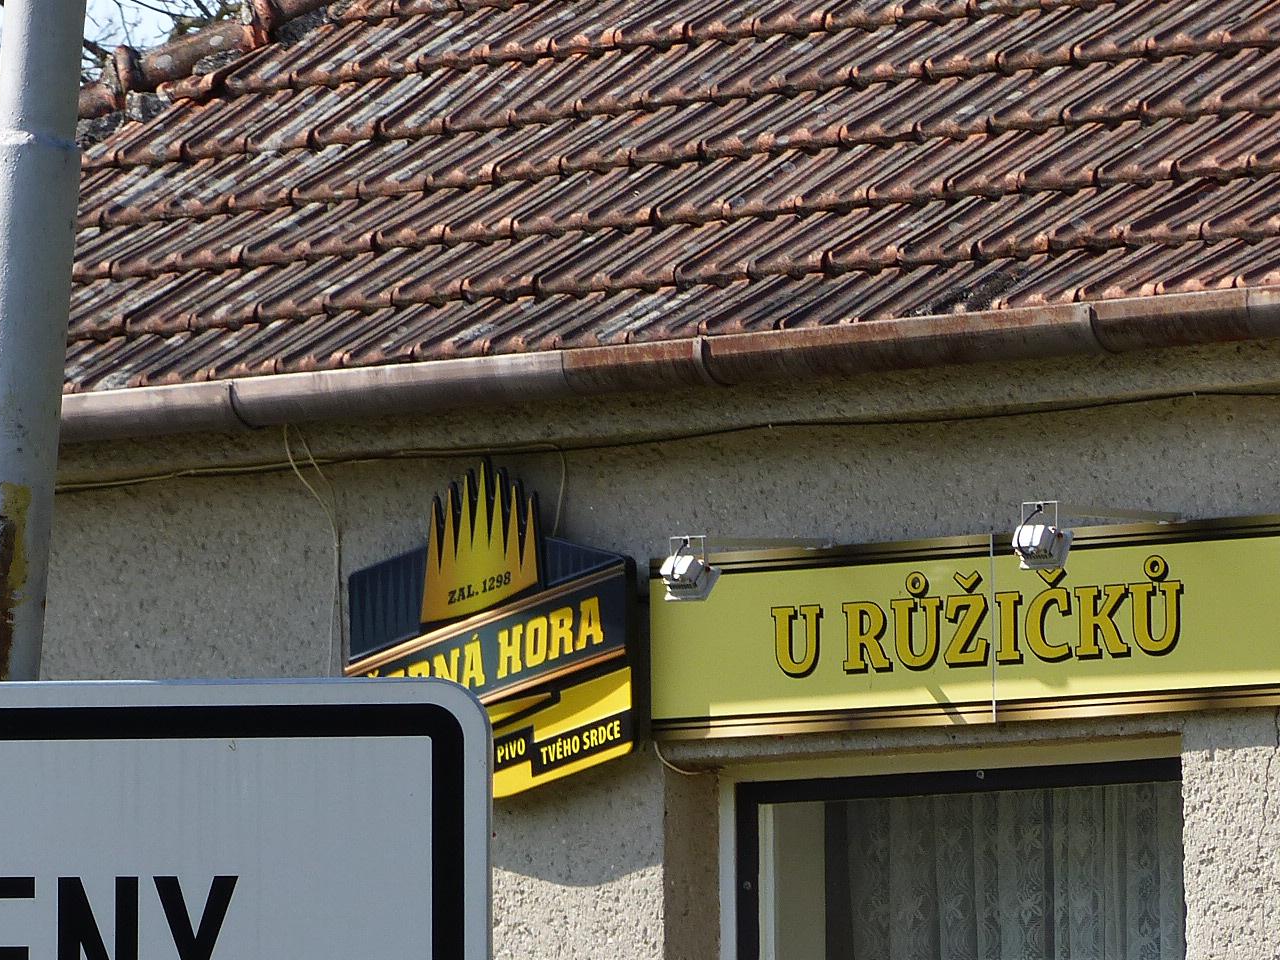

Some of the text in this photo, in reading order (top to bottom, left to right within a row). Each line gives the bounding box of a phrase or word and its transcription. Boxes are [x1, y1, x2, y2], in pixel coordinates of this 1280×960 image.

[448, 571, 511, 605] ZAL. 1298
[771, 555, 1185, 679] U RŮŽIČKŮ
[497, 596, 604, 679] HORA
[497, 720, 621, 765] PIVO TVÉHO SRDCE
